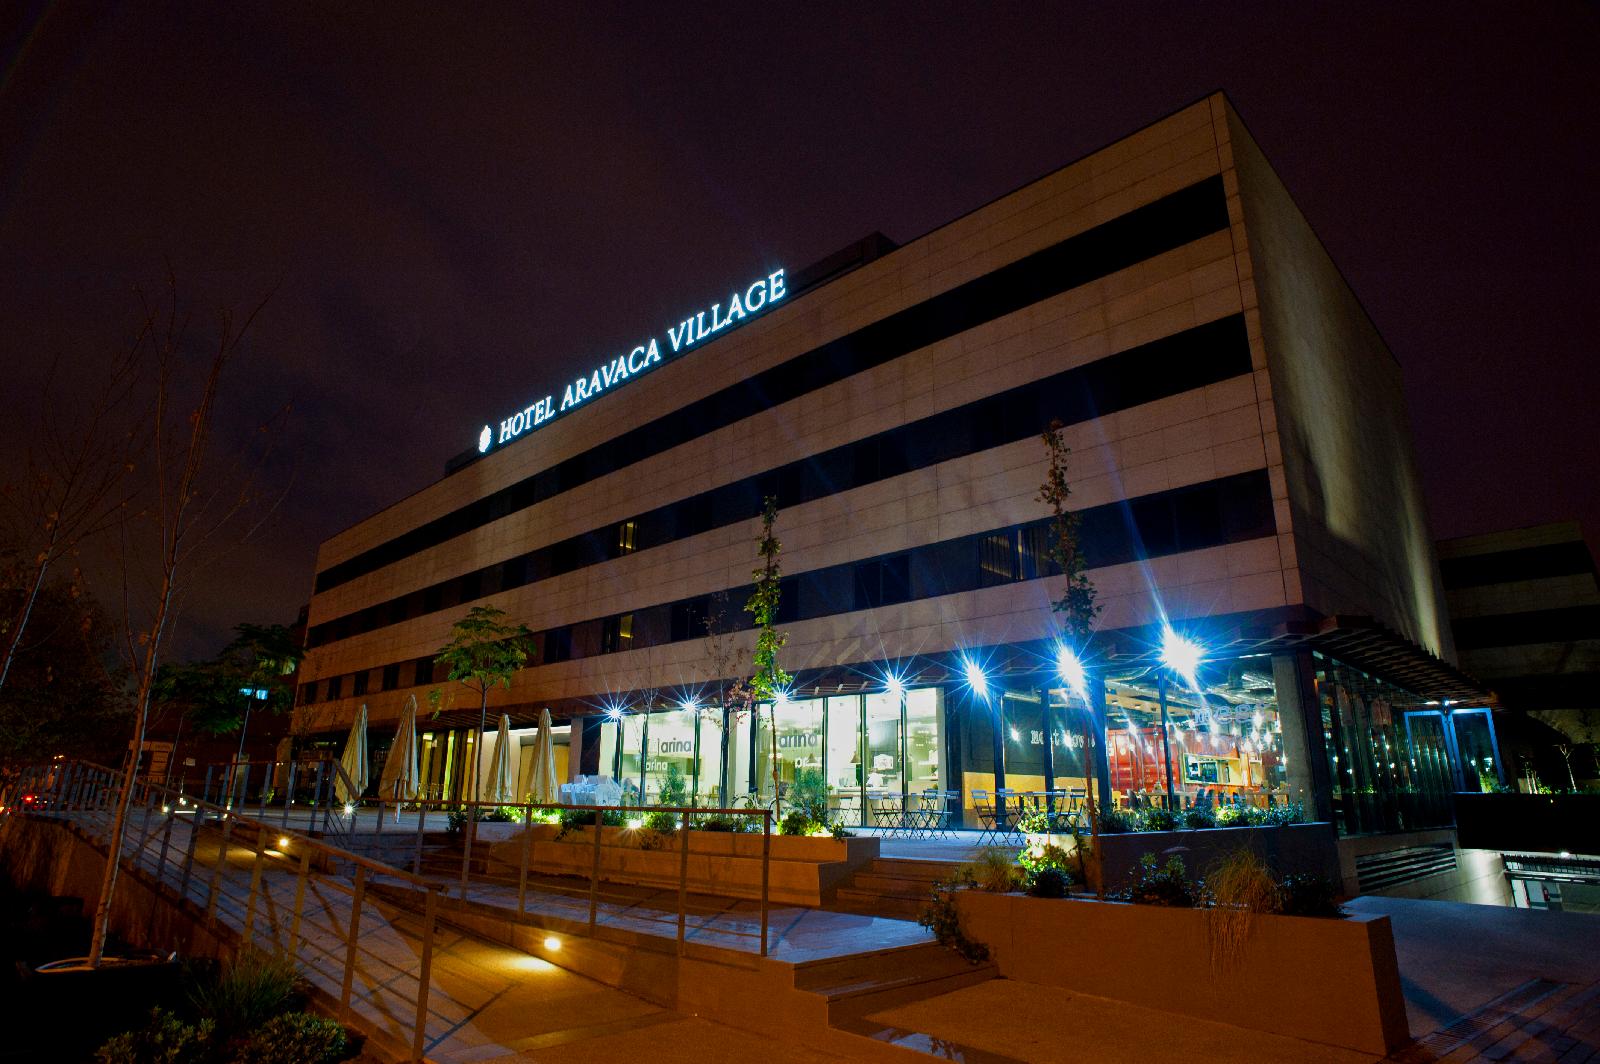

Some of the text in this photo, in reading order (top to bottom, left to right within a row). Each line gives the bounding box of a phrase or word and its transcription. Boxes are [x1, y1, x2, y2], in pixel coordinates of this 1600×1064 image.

[497, 268, 787, 445] HOTEL ARAVACA VILLAGE
